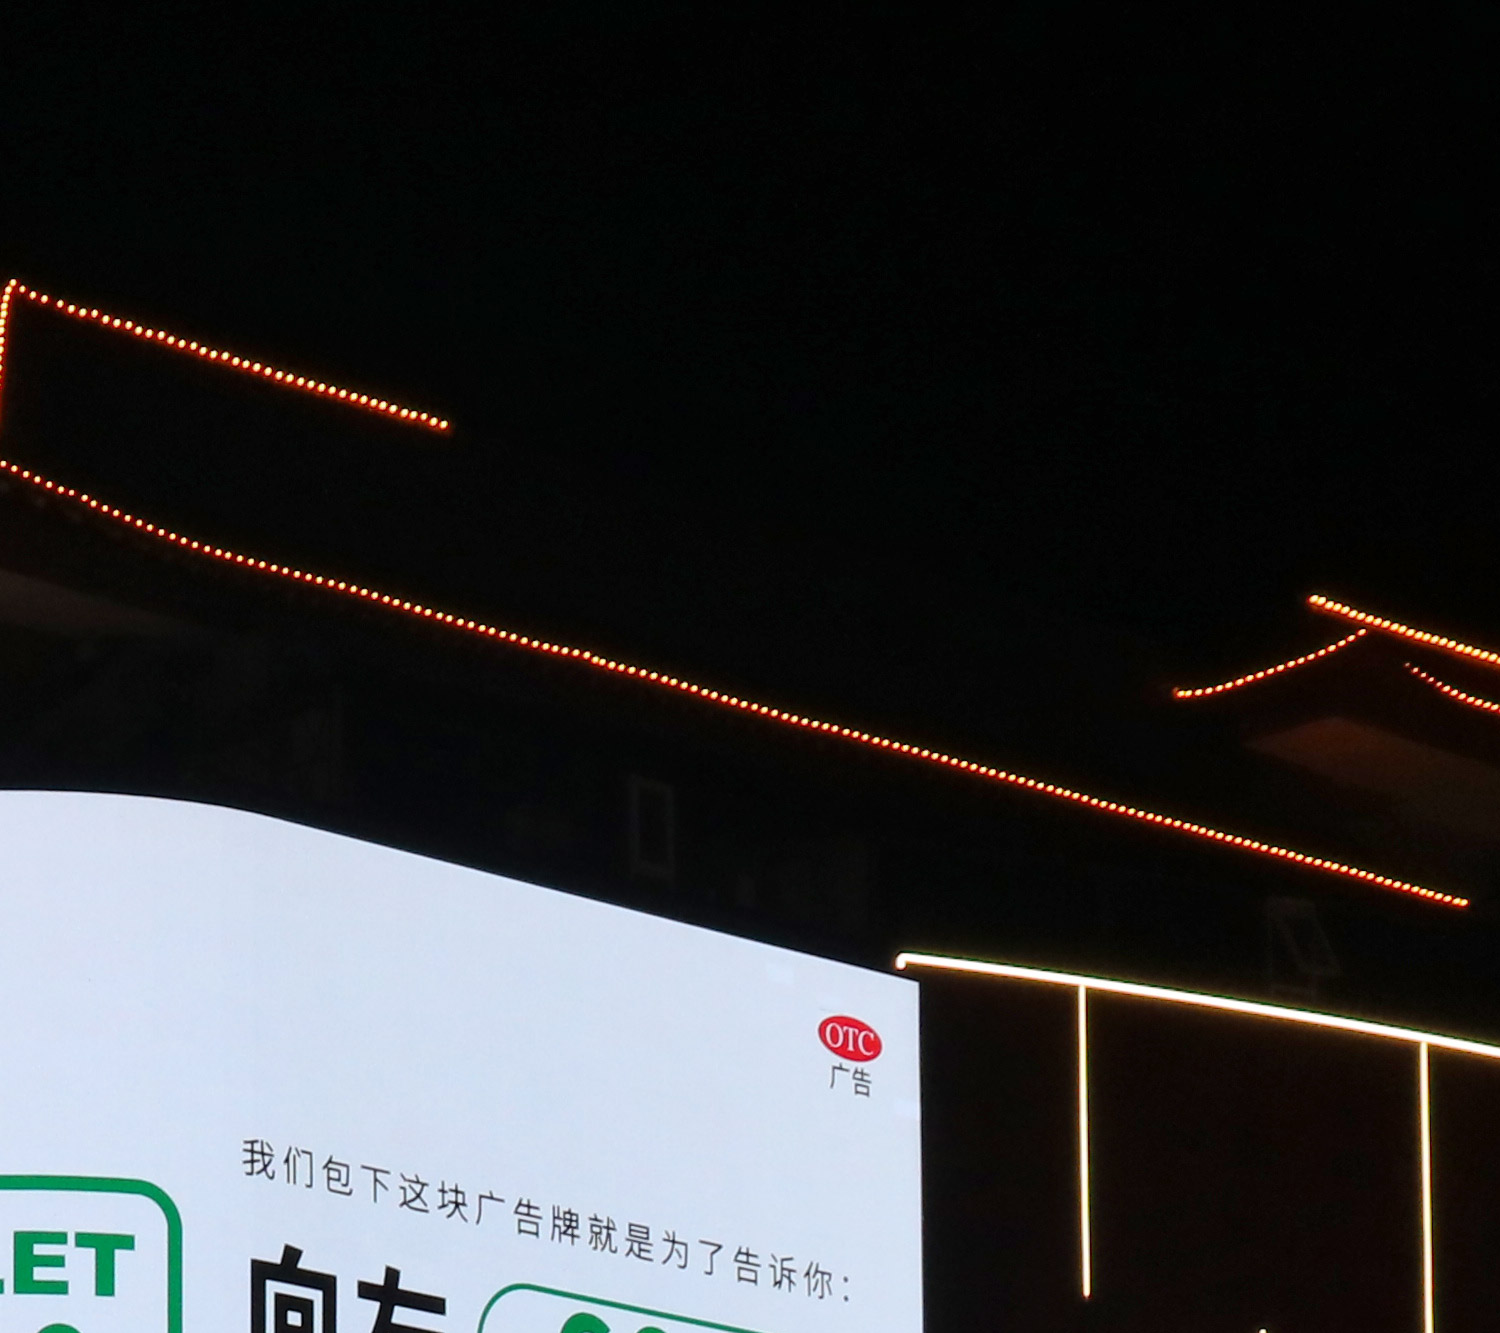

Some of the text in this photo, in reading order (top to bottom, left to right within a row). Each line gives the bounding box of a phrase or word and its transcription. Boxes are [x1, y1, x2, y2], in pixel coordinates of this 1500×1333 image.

[825, 1022, 875, 1056] OTC
[829, 1062, 872, 1098] 广告
[241, 1139, 853, 1304] 我们包下这块广告牌就是为了告诉你：
